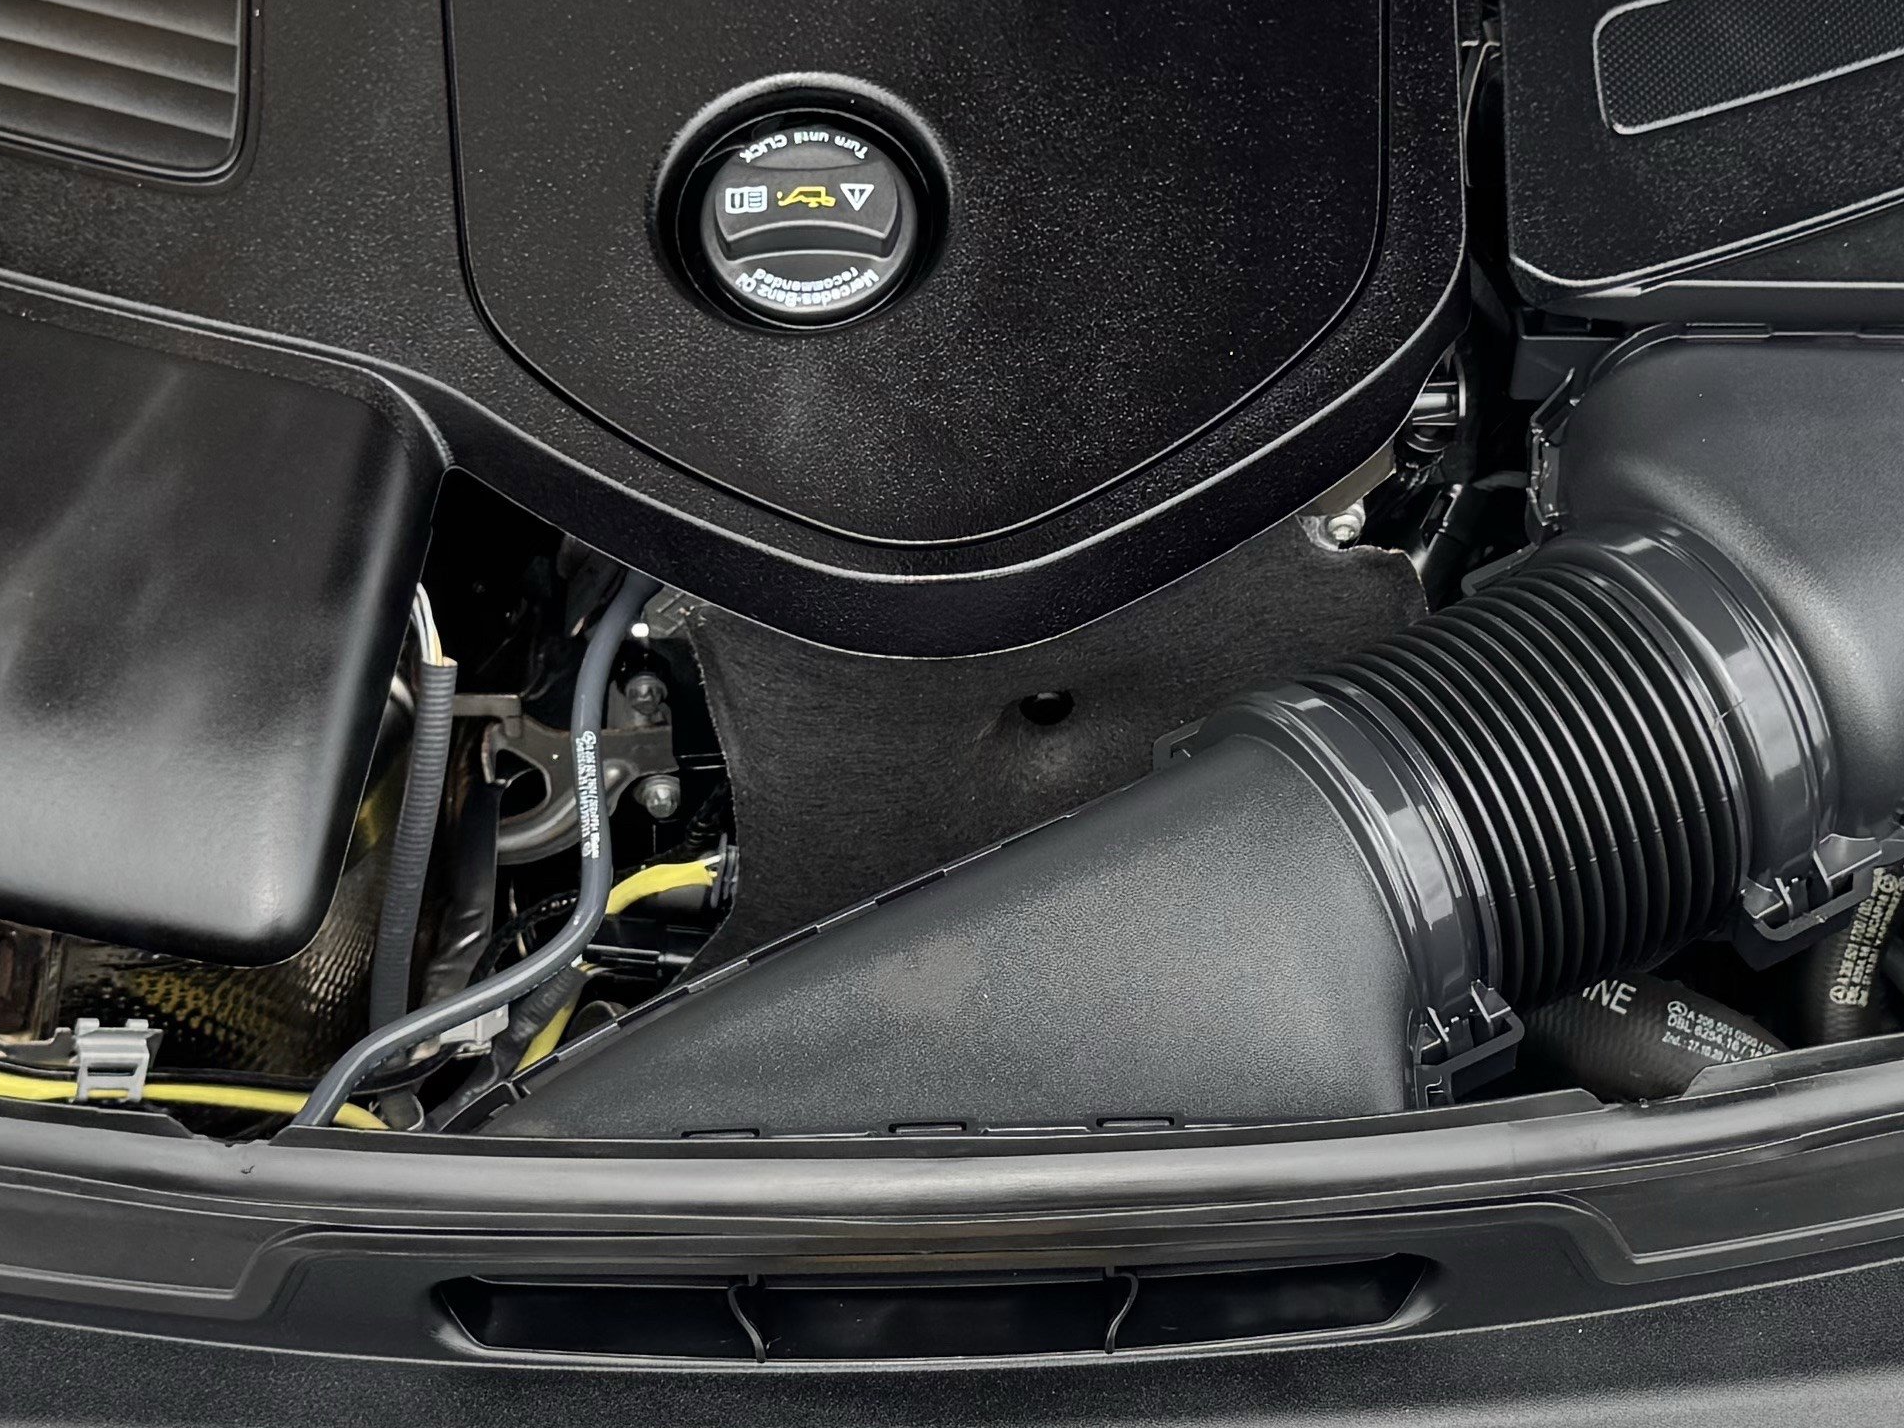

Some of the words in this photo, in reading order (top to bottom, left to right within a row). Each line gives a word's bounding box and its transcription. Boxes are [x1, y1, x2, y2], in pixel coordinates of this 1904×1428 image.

[740, 132, 788, 163] CLICK
[793, 130, 830, 145] until
[834, 132, 869, 160] Turn
[754, 266, 859, 292] recommended
